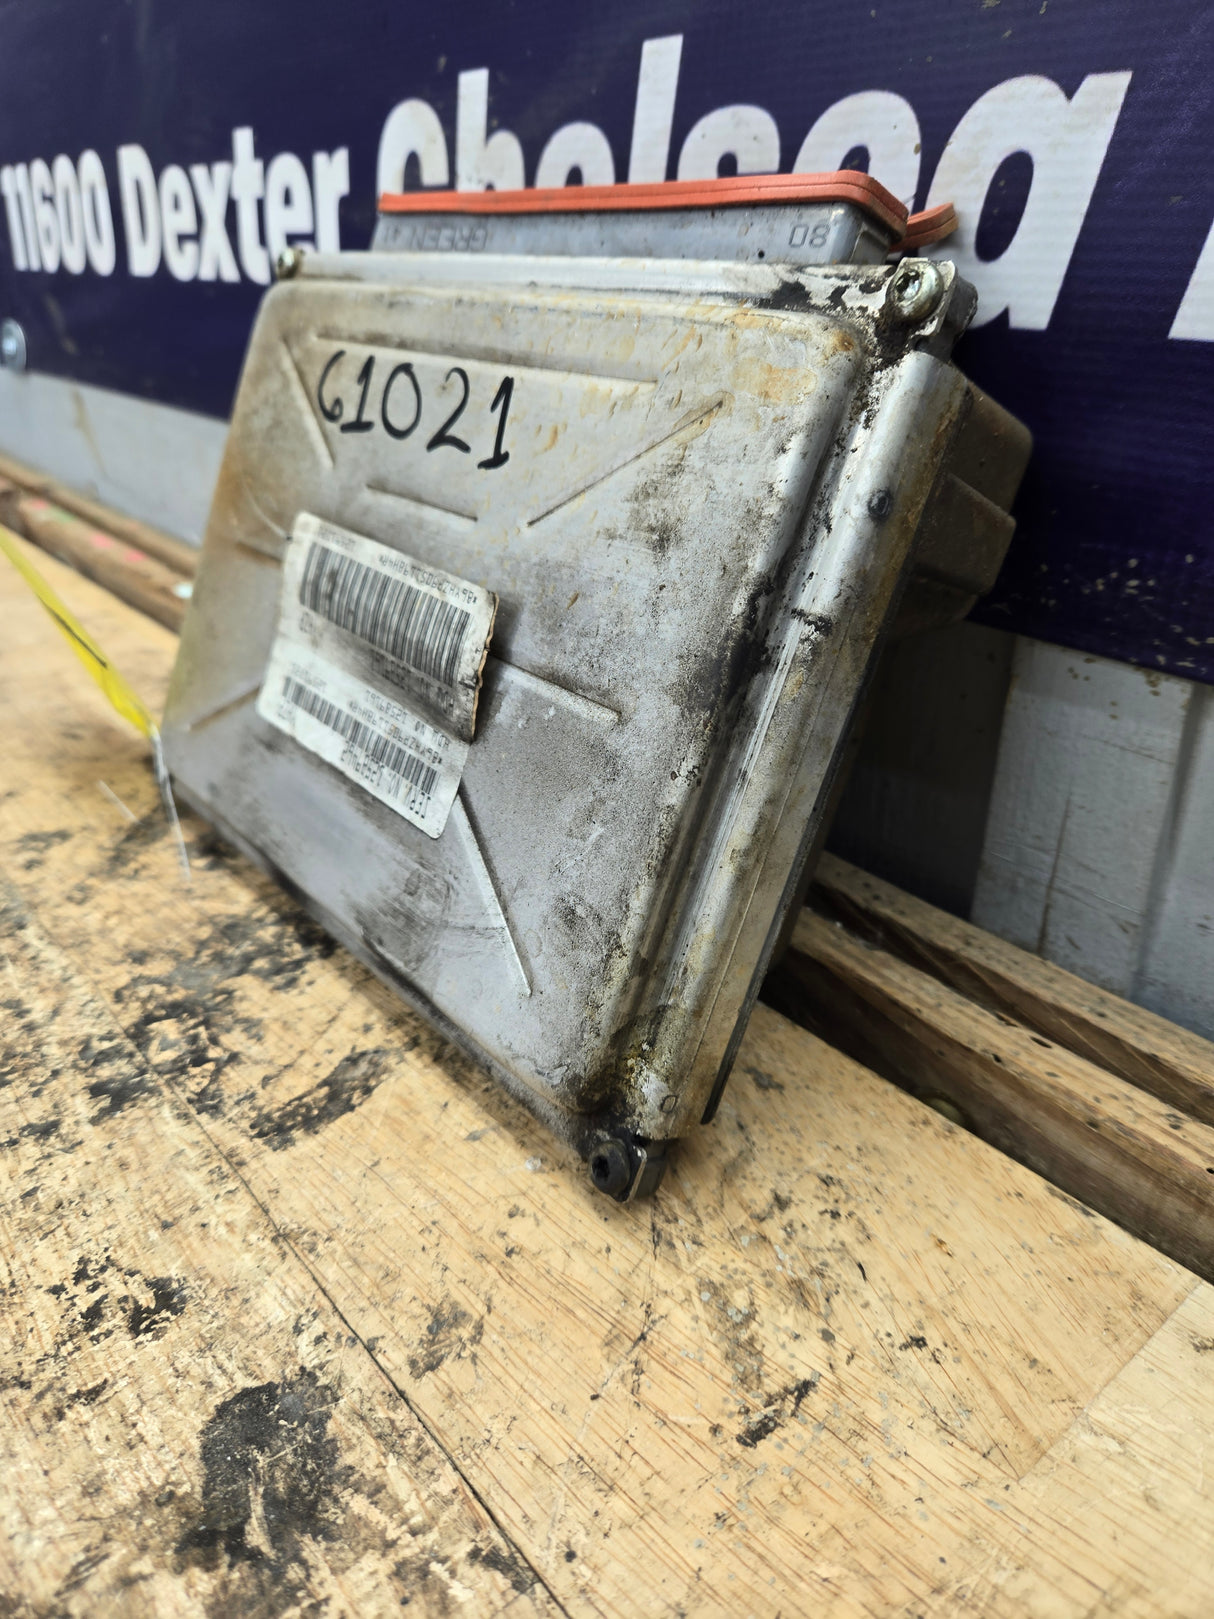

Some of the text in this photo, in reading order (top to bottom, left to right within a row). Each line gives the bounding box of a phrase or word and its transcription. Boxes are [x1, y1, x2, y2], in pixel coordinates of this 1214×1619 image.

[2, 149, 116, 276] 11600
[117, 126, 349, 285] Dexter
[318, 350, 514, 470] 61021
